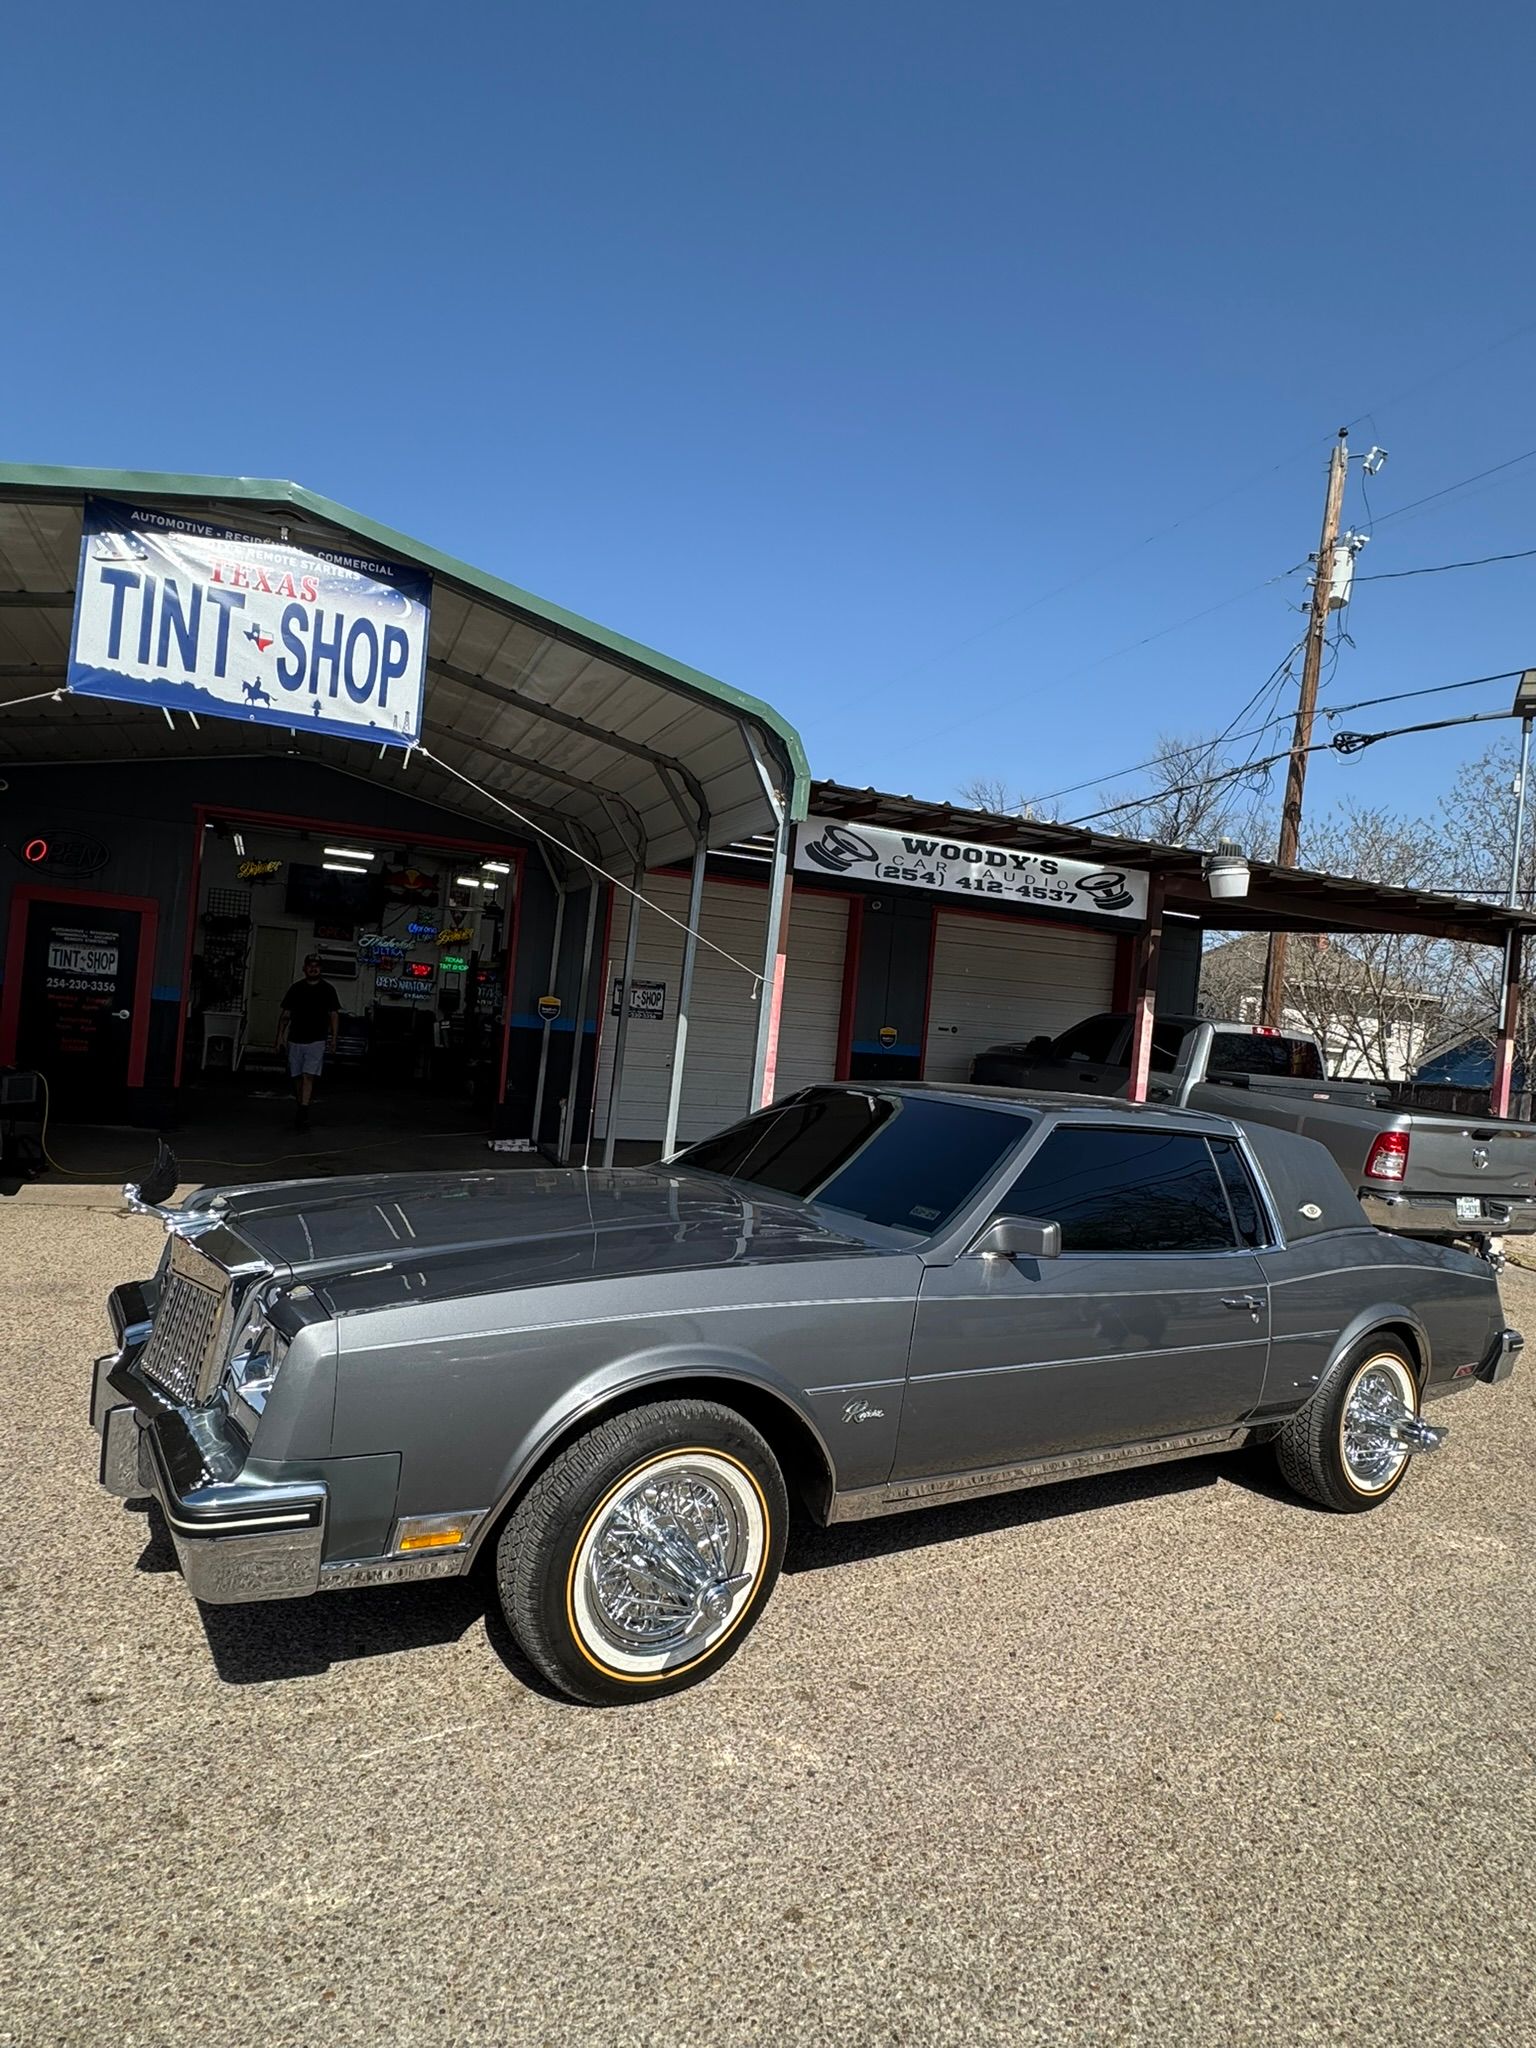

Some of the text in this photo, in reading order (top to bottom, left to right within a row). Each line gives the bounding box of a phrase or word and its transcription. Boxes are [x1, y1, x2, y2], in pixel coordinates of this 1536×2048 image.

[131, 511, 213, 536] AUTOMOTIVE
[318, 551, 394, 576] COMMERCIAL
[209, 559, 319, 603] TEXAS
[248, 547, 361, 581] REMOTE STARTERS
[100, 566, 409, 708] TINT SHOP
[892, 855, 1068, 889] CAR AUDIO
[902, 837, 1058, 875] WOODY'S
[874, 862, 1078, 904] (254) 412-4537
[52, 948, 116, 970] TINT SHOP
[46, 977, 116, 993] 254-230-3356
[641, 990, 662, 1006] SHOP
